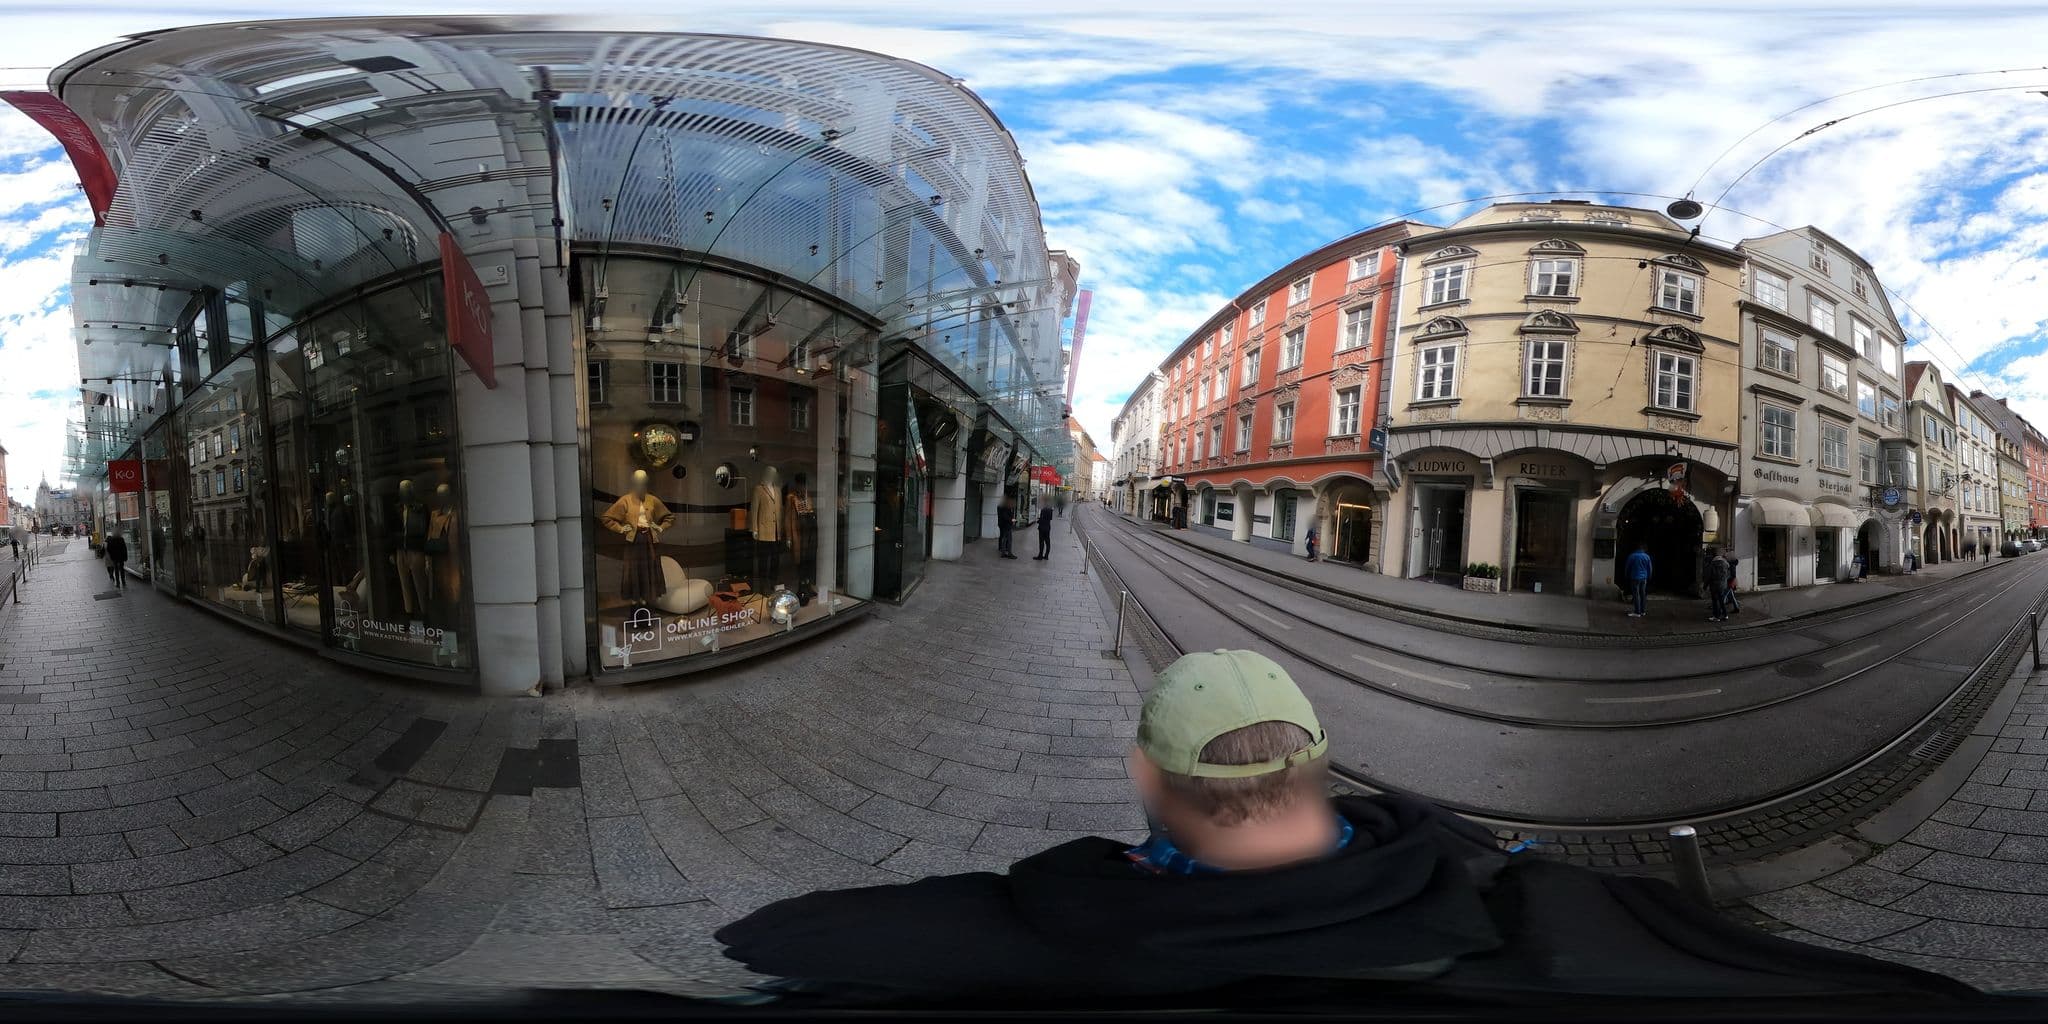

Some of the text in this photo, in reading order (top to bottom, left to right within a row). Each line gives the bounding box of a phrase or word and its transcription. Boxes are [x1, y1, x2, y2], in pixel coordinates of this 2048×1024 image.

[496, 266, 506, 277] 9
[1417, 461, 1466, 473] LUDWIG
[1519, 462, 1568, 477] REITER
[666, 607, 756, 634] ONLINE SHOP
[362, 619, 445, 638] ONLINE SHOP
